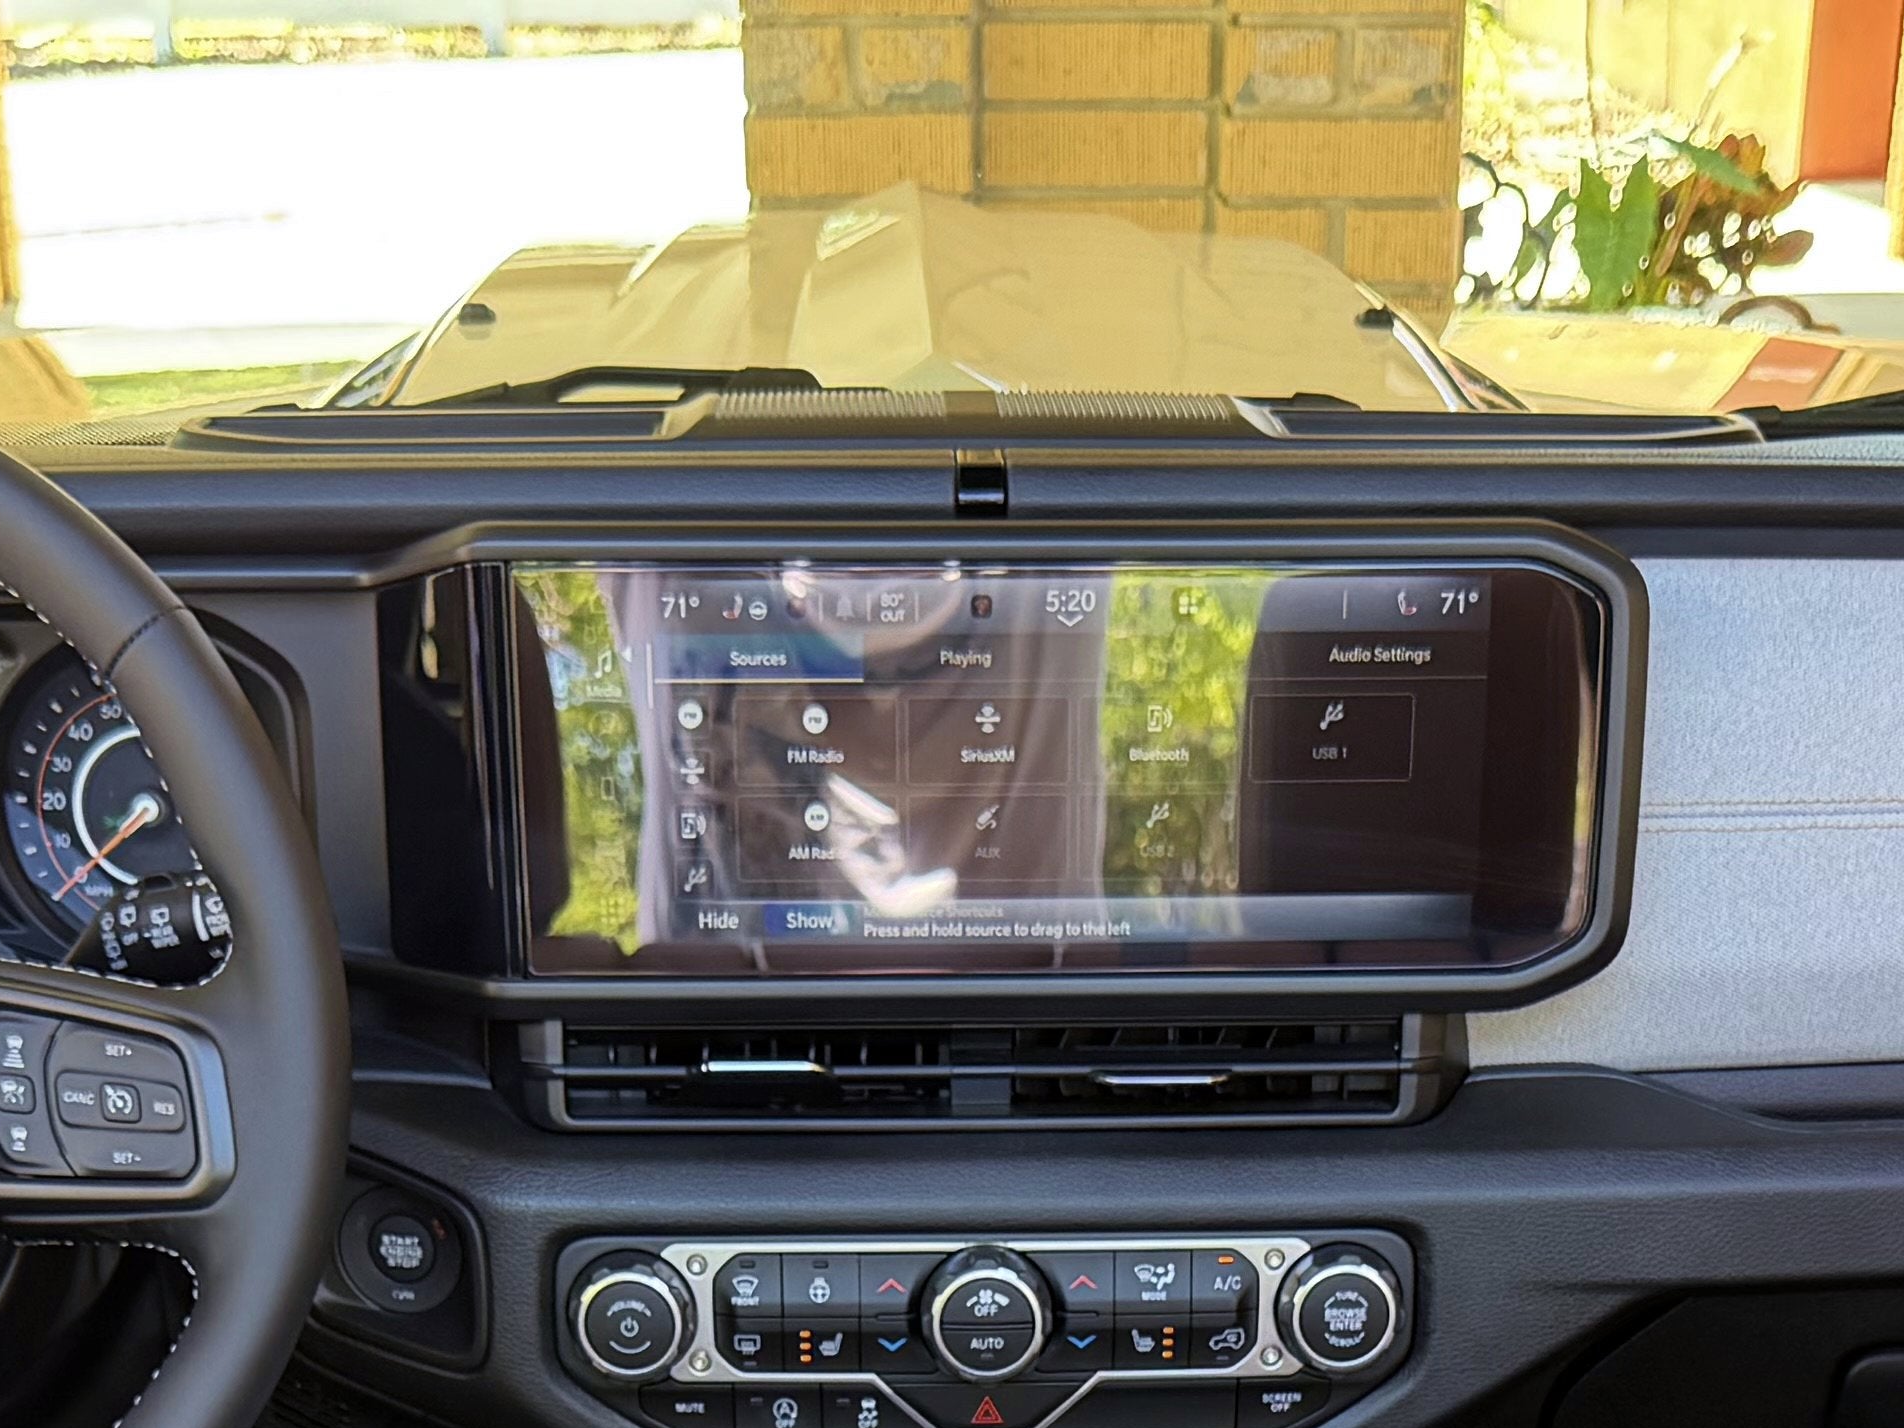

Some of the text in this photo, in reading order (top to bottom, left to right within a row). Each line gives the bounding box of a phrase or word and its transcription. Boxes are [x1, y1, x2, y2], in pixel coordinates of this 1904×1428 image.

[661, 594, 700, 619] 71°
[1046, 589, 1096, 612] 5:20
[1440, 592, 1479, 615] 71°
[730, 651, 787, 667] Sources
[940, 650, 992, 668] Playing
[1329, 647, 1431, 665] Audio Settings
[68, 722, 94, 742] 40
[787, 748, 844, 763] FM Radio
[961, 747, 1015, 763] SiriusXM
[1129, 747, 1189, 762] Bluetooth
[1313, 747, 1339, 760] USB
[51, 756, 73, 773] 30
[42, 791, 67, 811] 20
[789, 845, 810, 860] AM
[698, 911, 739, 930] Hide
[786, 912, 832, 930] Show
[863, 921, 1130, 939] Press and hold source to drag to the left
[1214, 1275, 1241, 1290] A/C
[1141, 1291, 1166, 1301] MODE
[974, 1304, 998, 1317] OFF
[1324, 1308, 1367, 1321] BROWSE
[1329, 1320, 1362, 1331] ENTER
[970, 1337, 1005, 1350] AUTO
[1262, 1392, 1302, 1403] SCREEN
[675, 1403, 705, 1413] MUTE
[1270, 1402, 1290, 1413] OFF
